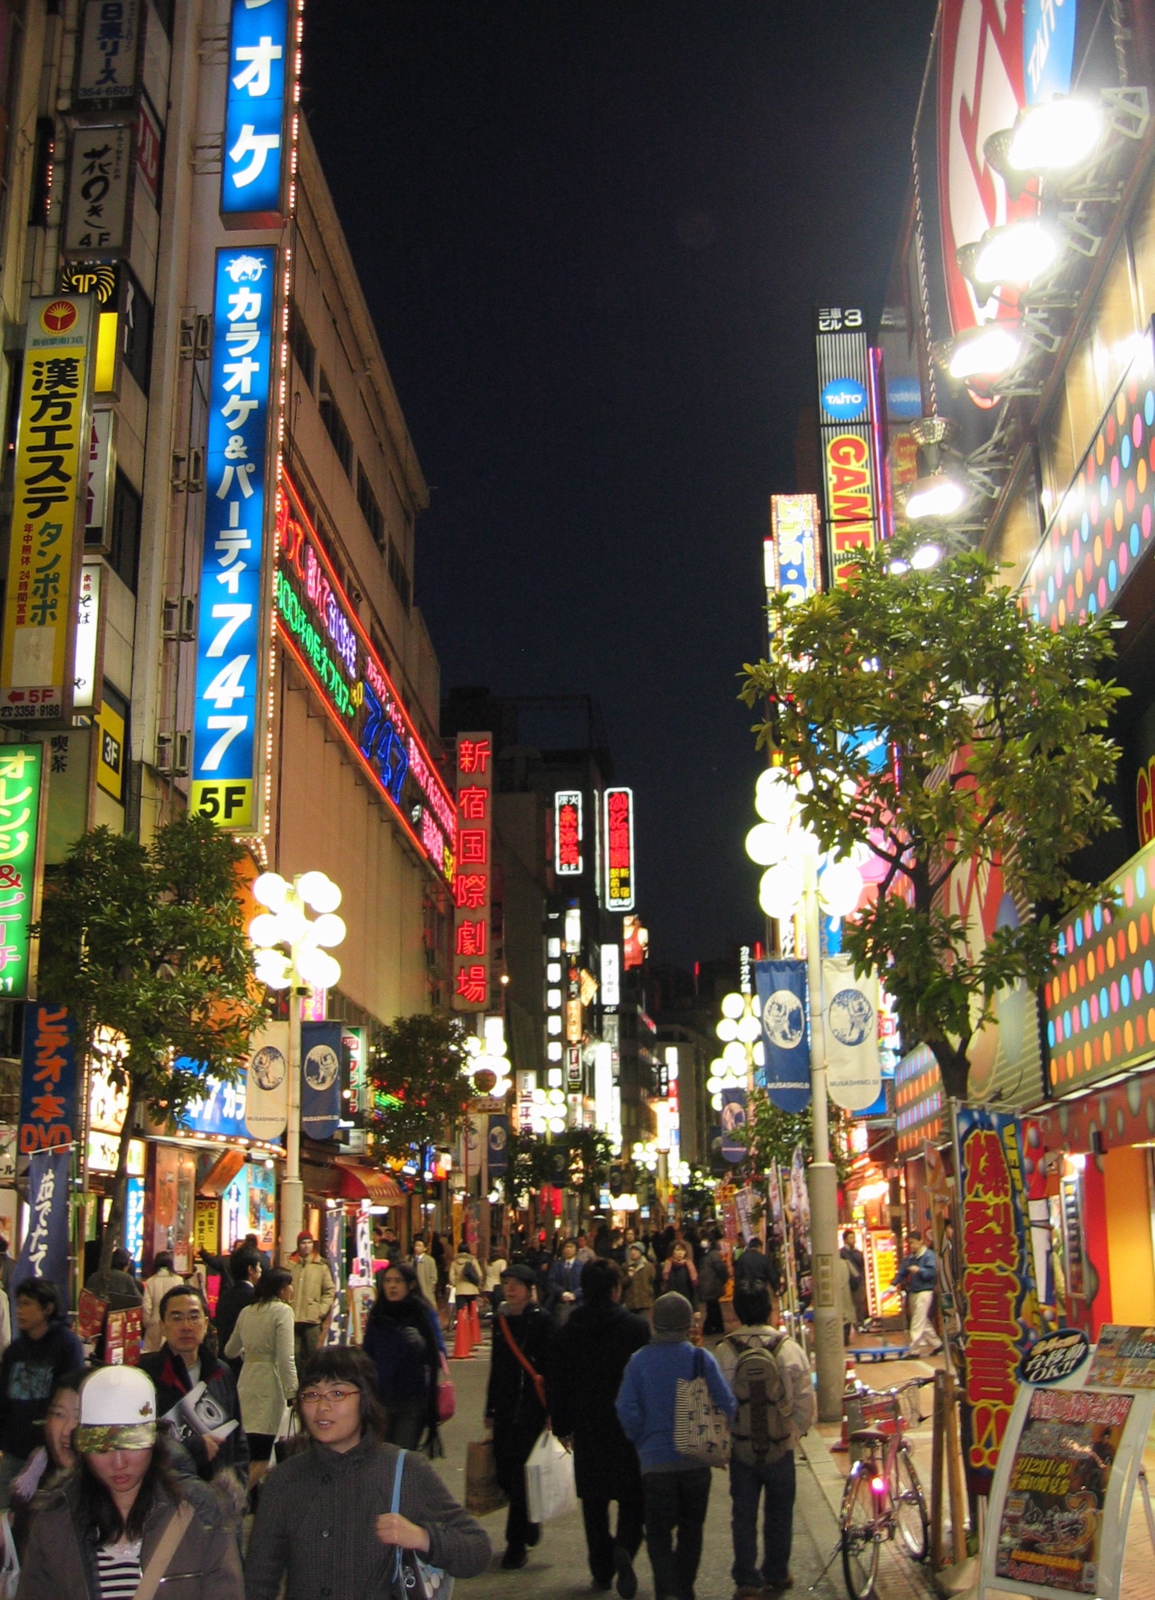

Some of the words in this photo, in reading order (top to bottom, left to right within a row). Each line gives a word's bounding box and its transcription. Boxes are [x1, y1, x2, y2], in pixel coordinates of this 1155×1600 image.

[79, 232, 111, 247] 4F
[818, 319, 842, 331] ビル
[844, 309, 862, 327] 3
[825, 392, 862, 404] TAITO
[22, 357, 80, 518] 漢方エステ
[827, 434, 872, 553] GAME
[21, 523, 34, 566] 年中無休
[30, 521, 63, 627] タンポポ
[28, 689, 54, 704] 5F
[51, 734, 68, 773] 喫茶
[104, 737, 118, 766] 3F
[360, 681, 409, 805] 747
[199, 786, 247, 820] 5F
[456, 740, 490, 1002] 新宿国際劇場
[604, 1005, 617, 1013] 4F
[20, 1123, 72, 1154] DVD
